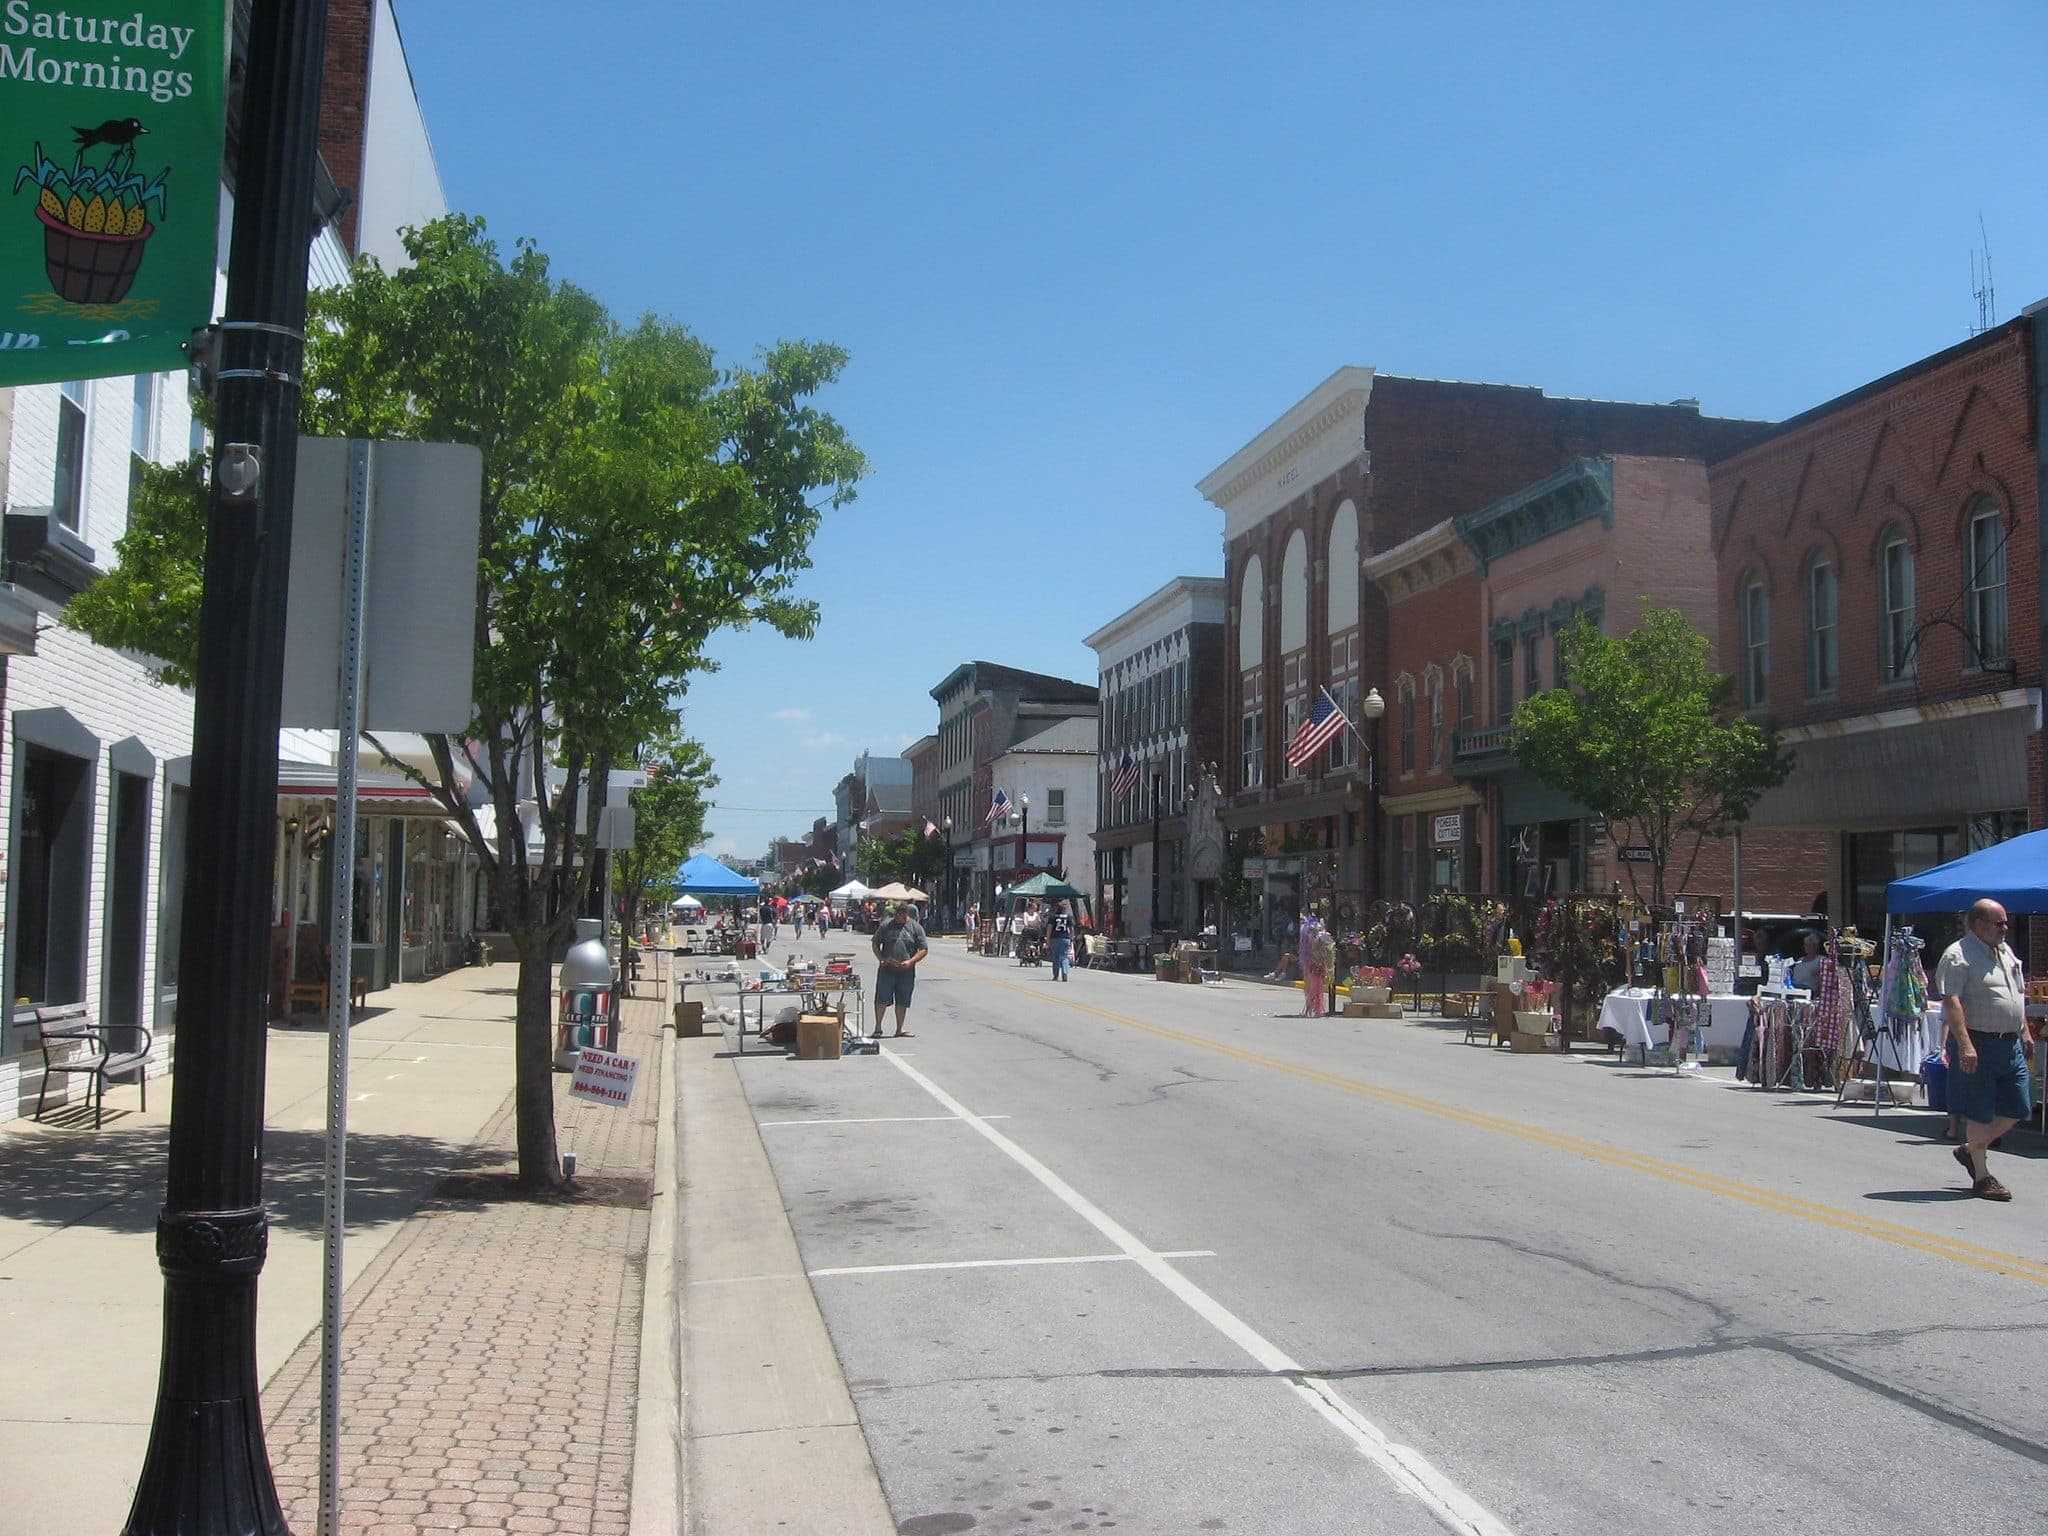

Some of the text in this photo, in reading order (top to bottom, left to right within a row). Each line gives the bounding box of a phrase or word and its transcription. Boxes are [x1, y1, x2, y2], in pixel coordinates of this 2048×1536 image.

[4, 0, 195, 60] Saturday
[0, 44, 194, 103] Mornings
[1440, 816, 1459, 828] CHEESE
[1438, 827, 1461, 839] COTTAGE
[581, 1051, 604, 1064] NEED
[604, 1057, 610, 1066] A
[611, 1058, 629, 1070] CAR
[578, 1065, 594, 1074] NEED
[594, 1068, 628, 1082] FINANCING
